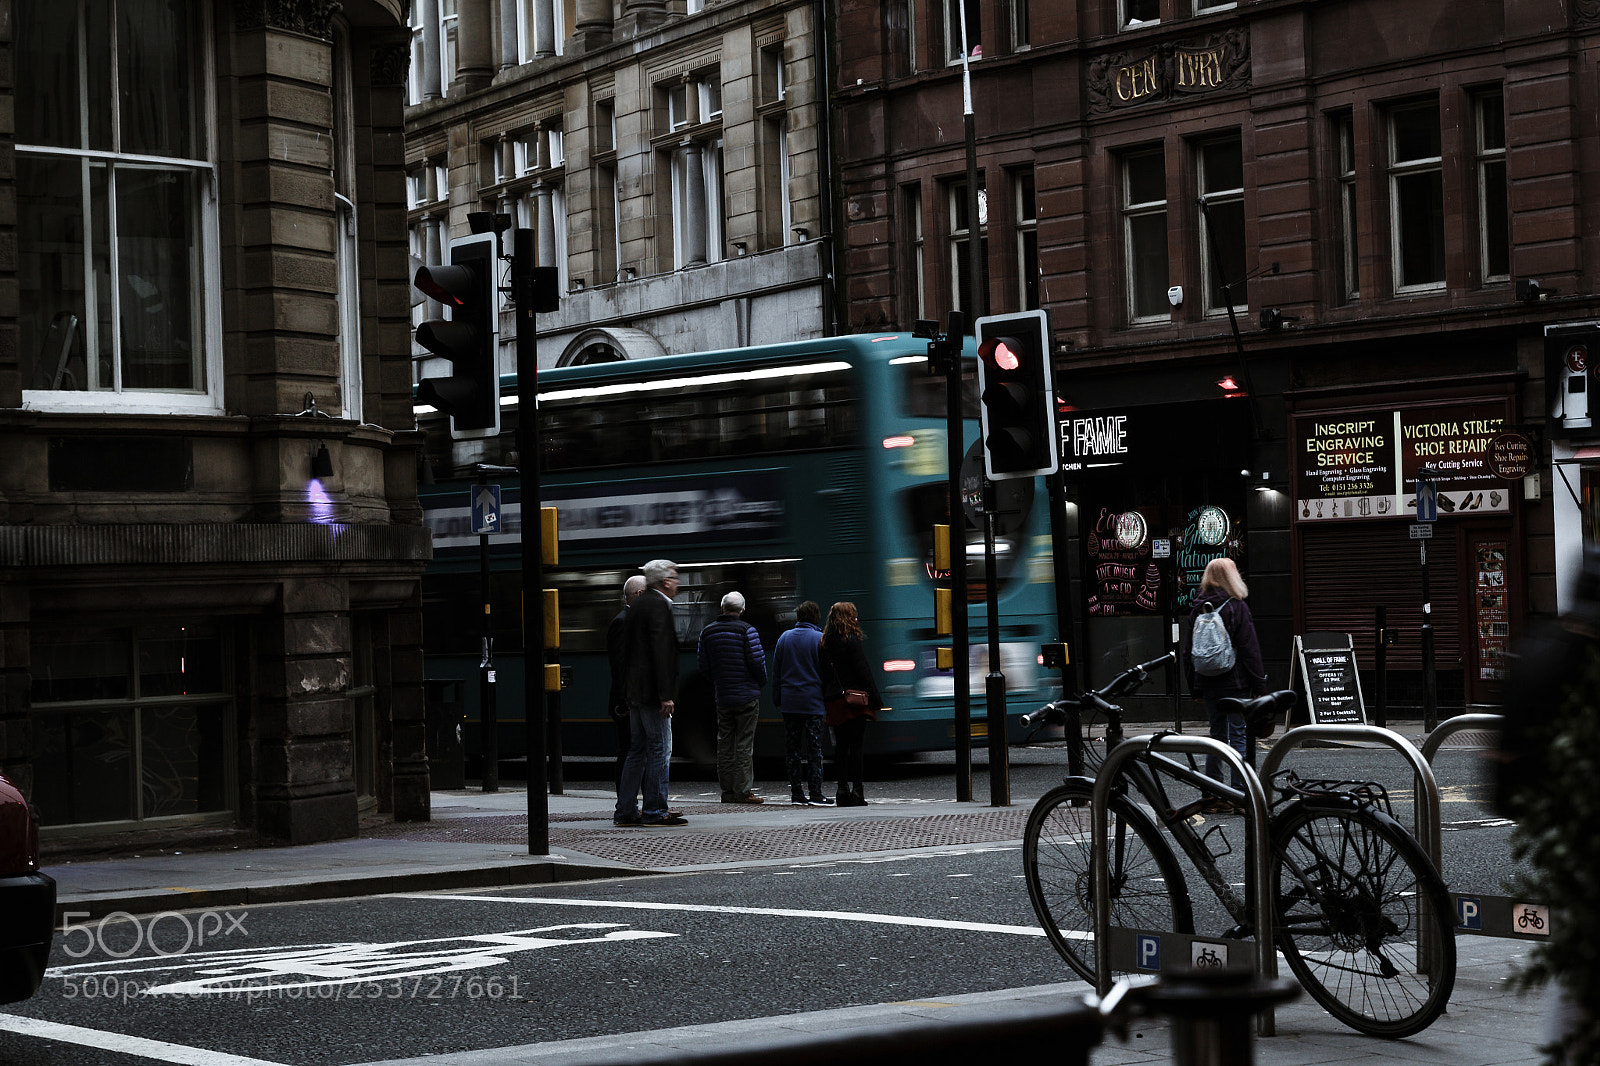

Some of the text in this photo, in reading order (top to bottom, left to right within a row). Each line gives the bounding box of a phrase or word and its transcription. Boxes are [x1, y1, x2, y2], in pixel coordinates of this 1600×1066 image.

[1315, 420, 1376, 436] INSCRIPT
[1404, 422, 1460, 439] VICTORIA
[1058, 416, 1128, 457] F FAME
[1306, 436, 1384, 452] ENGRAVING
[1414, 440, 1445, 456] SHOE
[1318, 452, 1374, 466] SERVICE
[1425, 458, 1483, 470] Key Cutting Service
[1114, 566, 1136, 579] MUSIC
[1463, 901, 1478, 926] P
[1142, 938, 1156, 966] P
